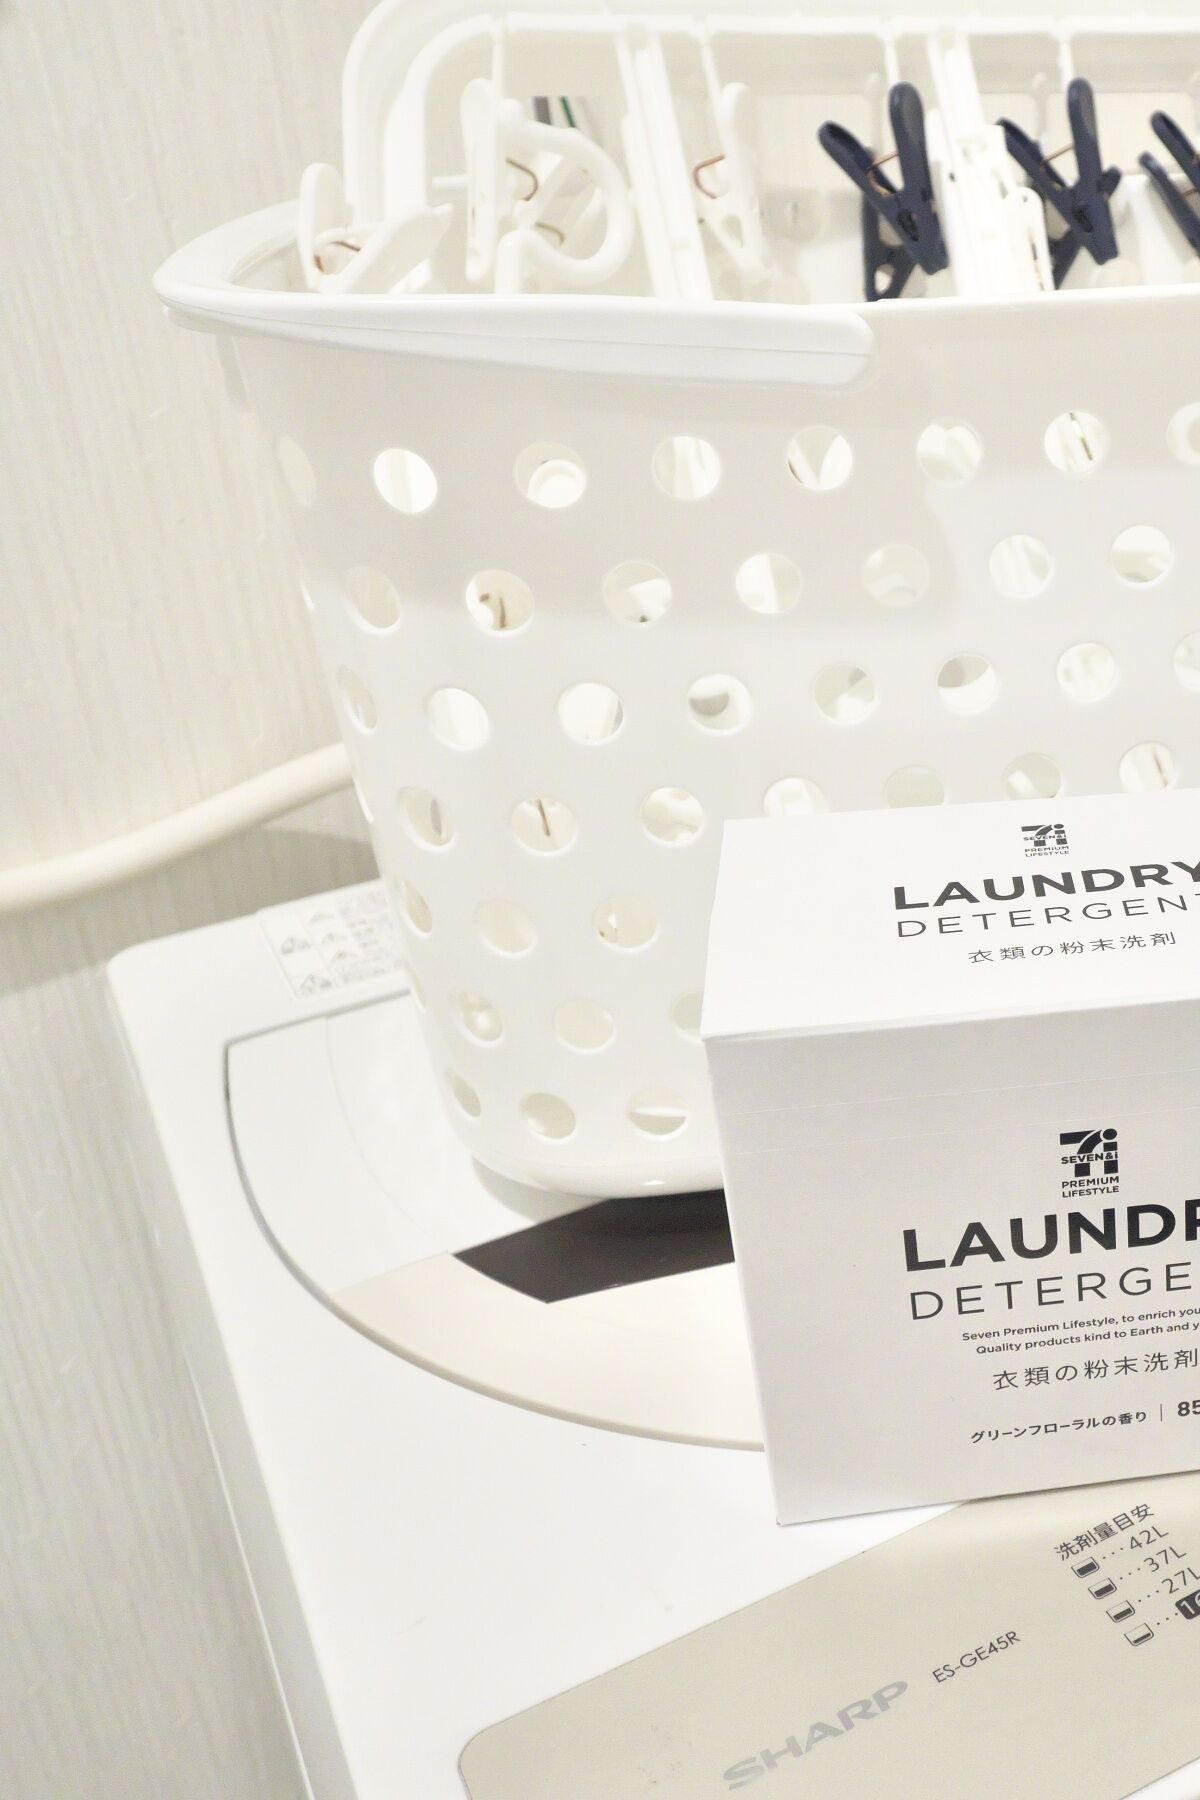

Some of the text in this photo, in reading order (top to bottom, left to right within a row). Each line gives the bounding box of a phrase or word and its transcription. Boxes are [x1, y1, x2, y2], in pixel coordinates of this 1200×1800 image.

[1024, 845, 1069, 853] PREMIUM
[968, 931, 1177, 964] 衣類の粉末洗剤
[1062, 1176, 1119, 1189] PREMIUM
[1062, 1186, 1119, 1198] LIFESTYLE
[962, 1330, 1000, 1341] Seven
[1004, 1323, 1059, 1335] Premium
[1062, 1317, 1119, 1331] Lifestyle,
[1122, 1314, 1134, 1322] to
[1138, 1308, 1176, 1321] enrich
[976, 1342, 1021, 1354] Quality
[1025, 1335, 1081, 1349] products
[1084, 1330, 1111, 1341] kind
[1114, 1329, 1127, 1338] to
[1130, 1324, 1163, 1337] Earth
[1166, 1322, 1190, 1333] and
[992, 1348, 1199, 1391] 衣類の粉末洗剤
[970, 1410, 1148, 1444] グリーンフローラルの香り
[1053, 1502, 1155, 1562] 洗剤量目安
[1129, 1523, 1170, 1552] 42L
[1143, 1544, 1188, 1574] 37L
[931, 1630, 1021, 1683] ES-GE45R
[722, 1680, 908, 1791] SHARP
